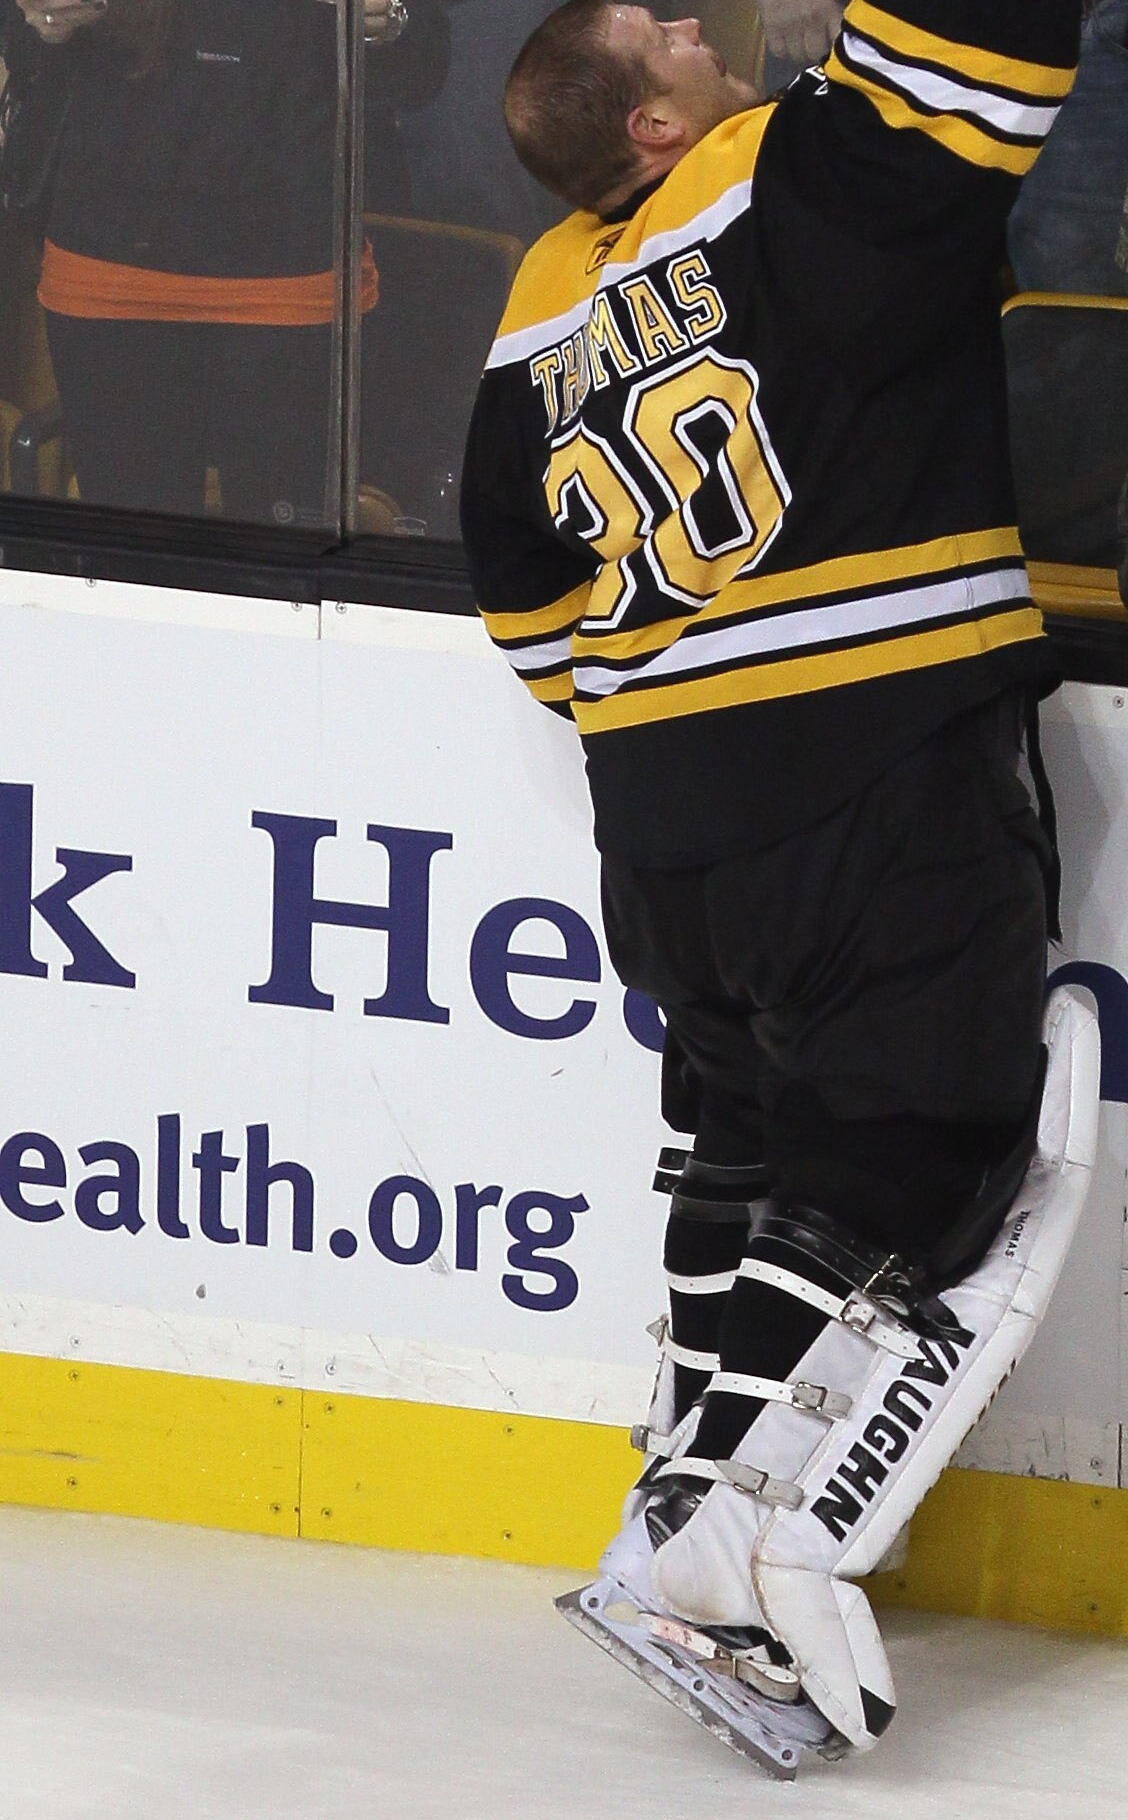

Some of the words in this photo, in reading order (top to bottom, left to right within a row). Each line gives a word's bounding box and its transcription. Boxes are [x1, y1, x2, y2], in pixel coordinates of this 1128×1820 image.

[529, 248, 727, 438] THMAS
[0, 1112, 590, 1312] ealth.org
[1004, 1210, 1032, 1258] THOMAS
